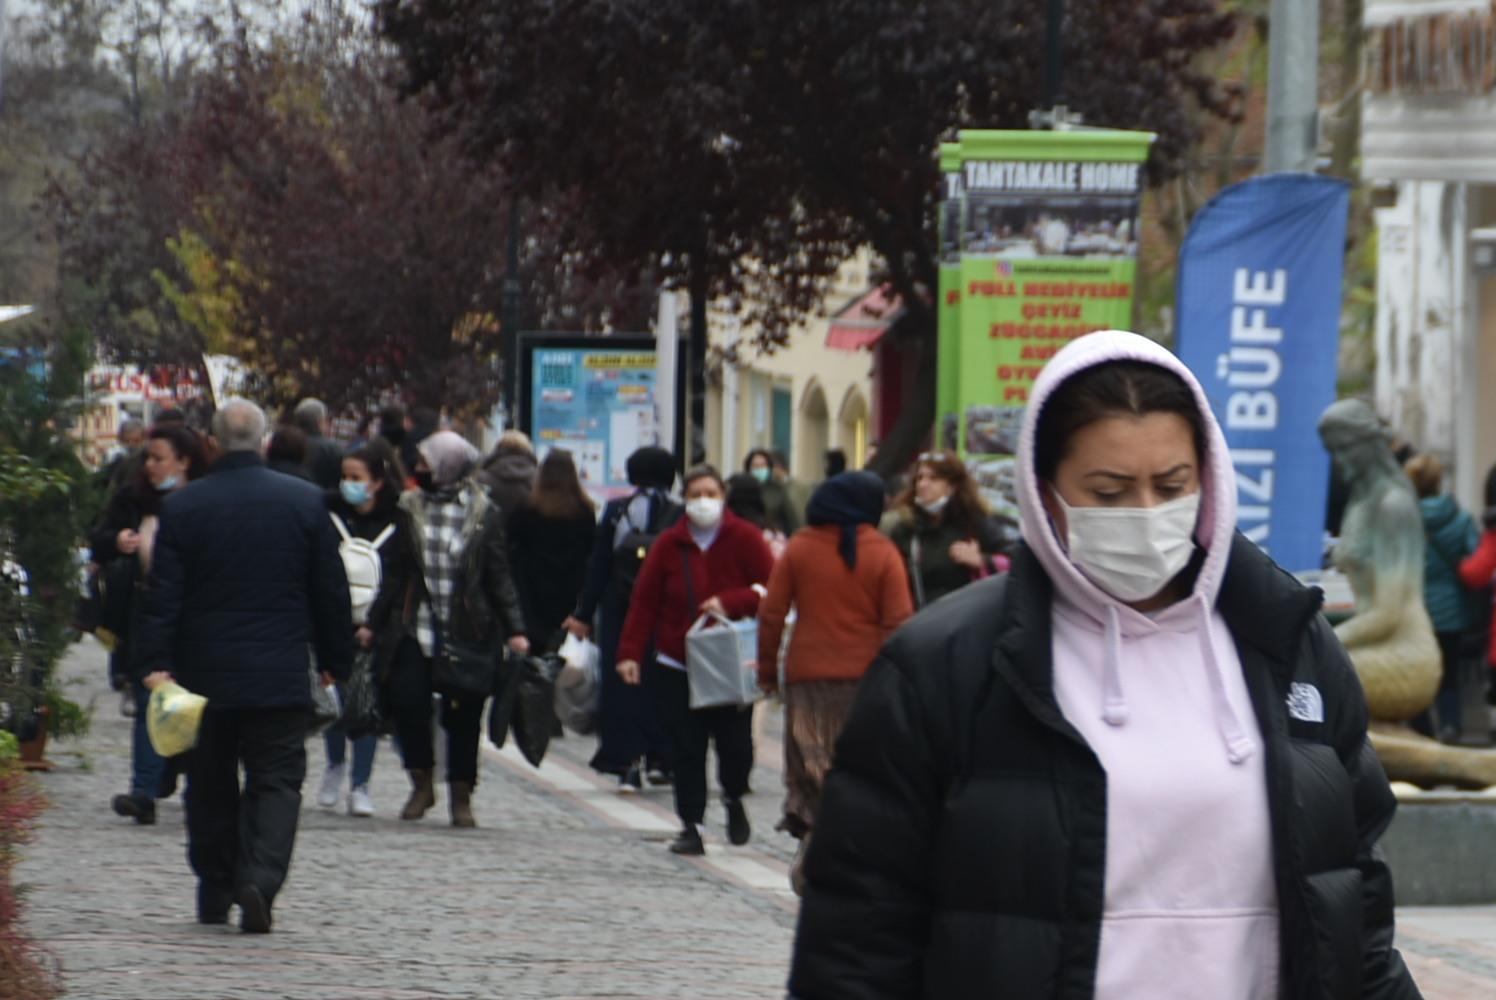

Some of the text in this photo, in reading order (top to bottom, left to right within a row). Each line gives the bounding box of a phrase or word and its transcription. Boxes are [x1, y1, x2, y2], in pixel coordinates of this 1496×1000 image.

[1080, 162, 1138, 191] HOME
[1216, 267, 1287, 556] IZI BÜFE
